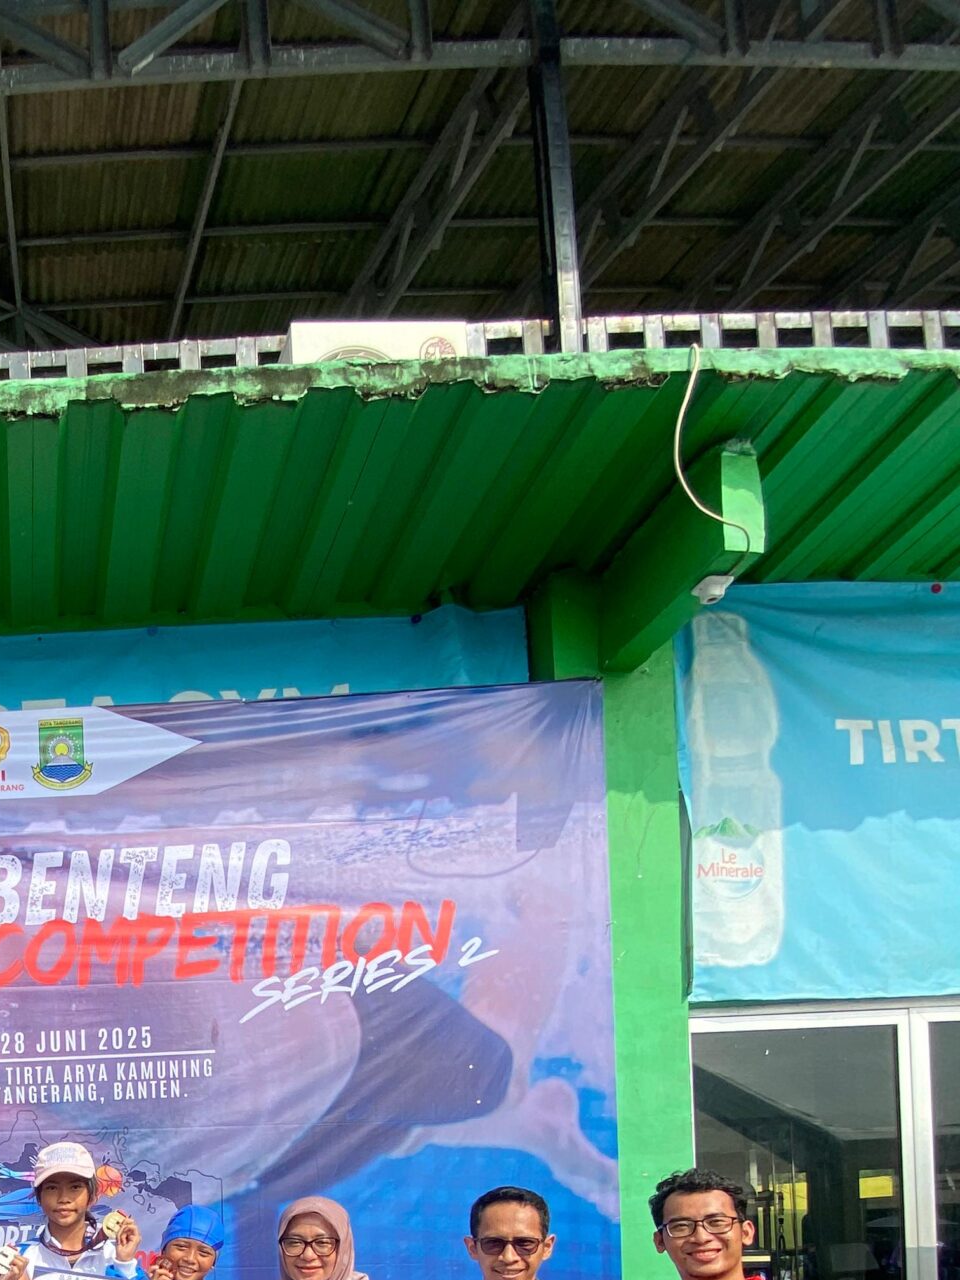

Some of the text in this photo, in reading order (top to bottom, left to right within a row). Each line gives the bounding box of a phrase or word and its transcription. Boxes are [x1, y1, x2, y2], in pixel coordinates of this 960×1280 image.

[721, 848, 737, 865] Le
[696, 862, 764, 879] Minerale
[239, 936, 500, 1024] SERIES 2
[1, 1032, 25, 1055] 28
[36, 1029, 86, 1053] JUNI
[98, 1026, 152, 1050] 2025
[6, 1065, 54, 1086] TIRTA
[63, 1063, 108, 1083] ARYA
[116, 1058, 213, 1081] KAMUNING
[113, 1079, 188, 1100] BANTEN.
